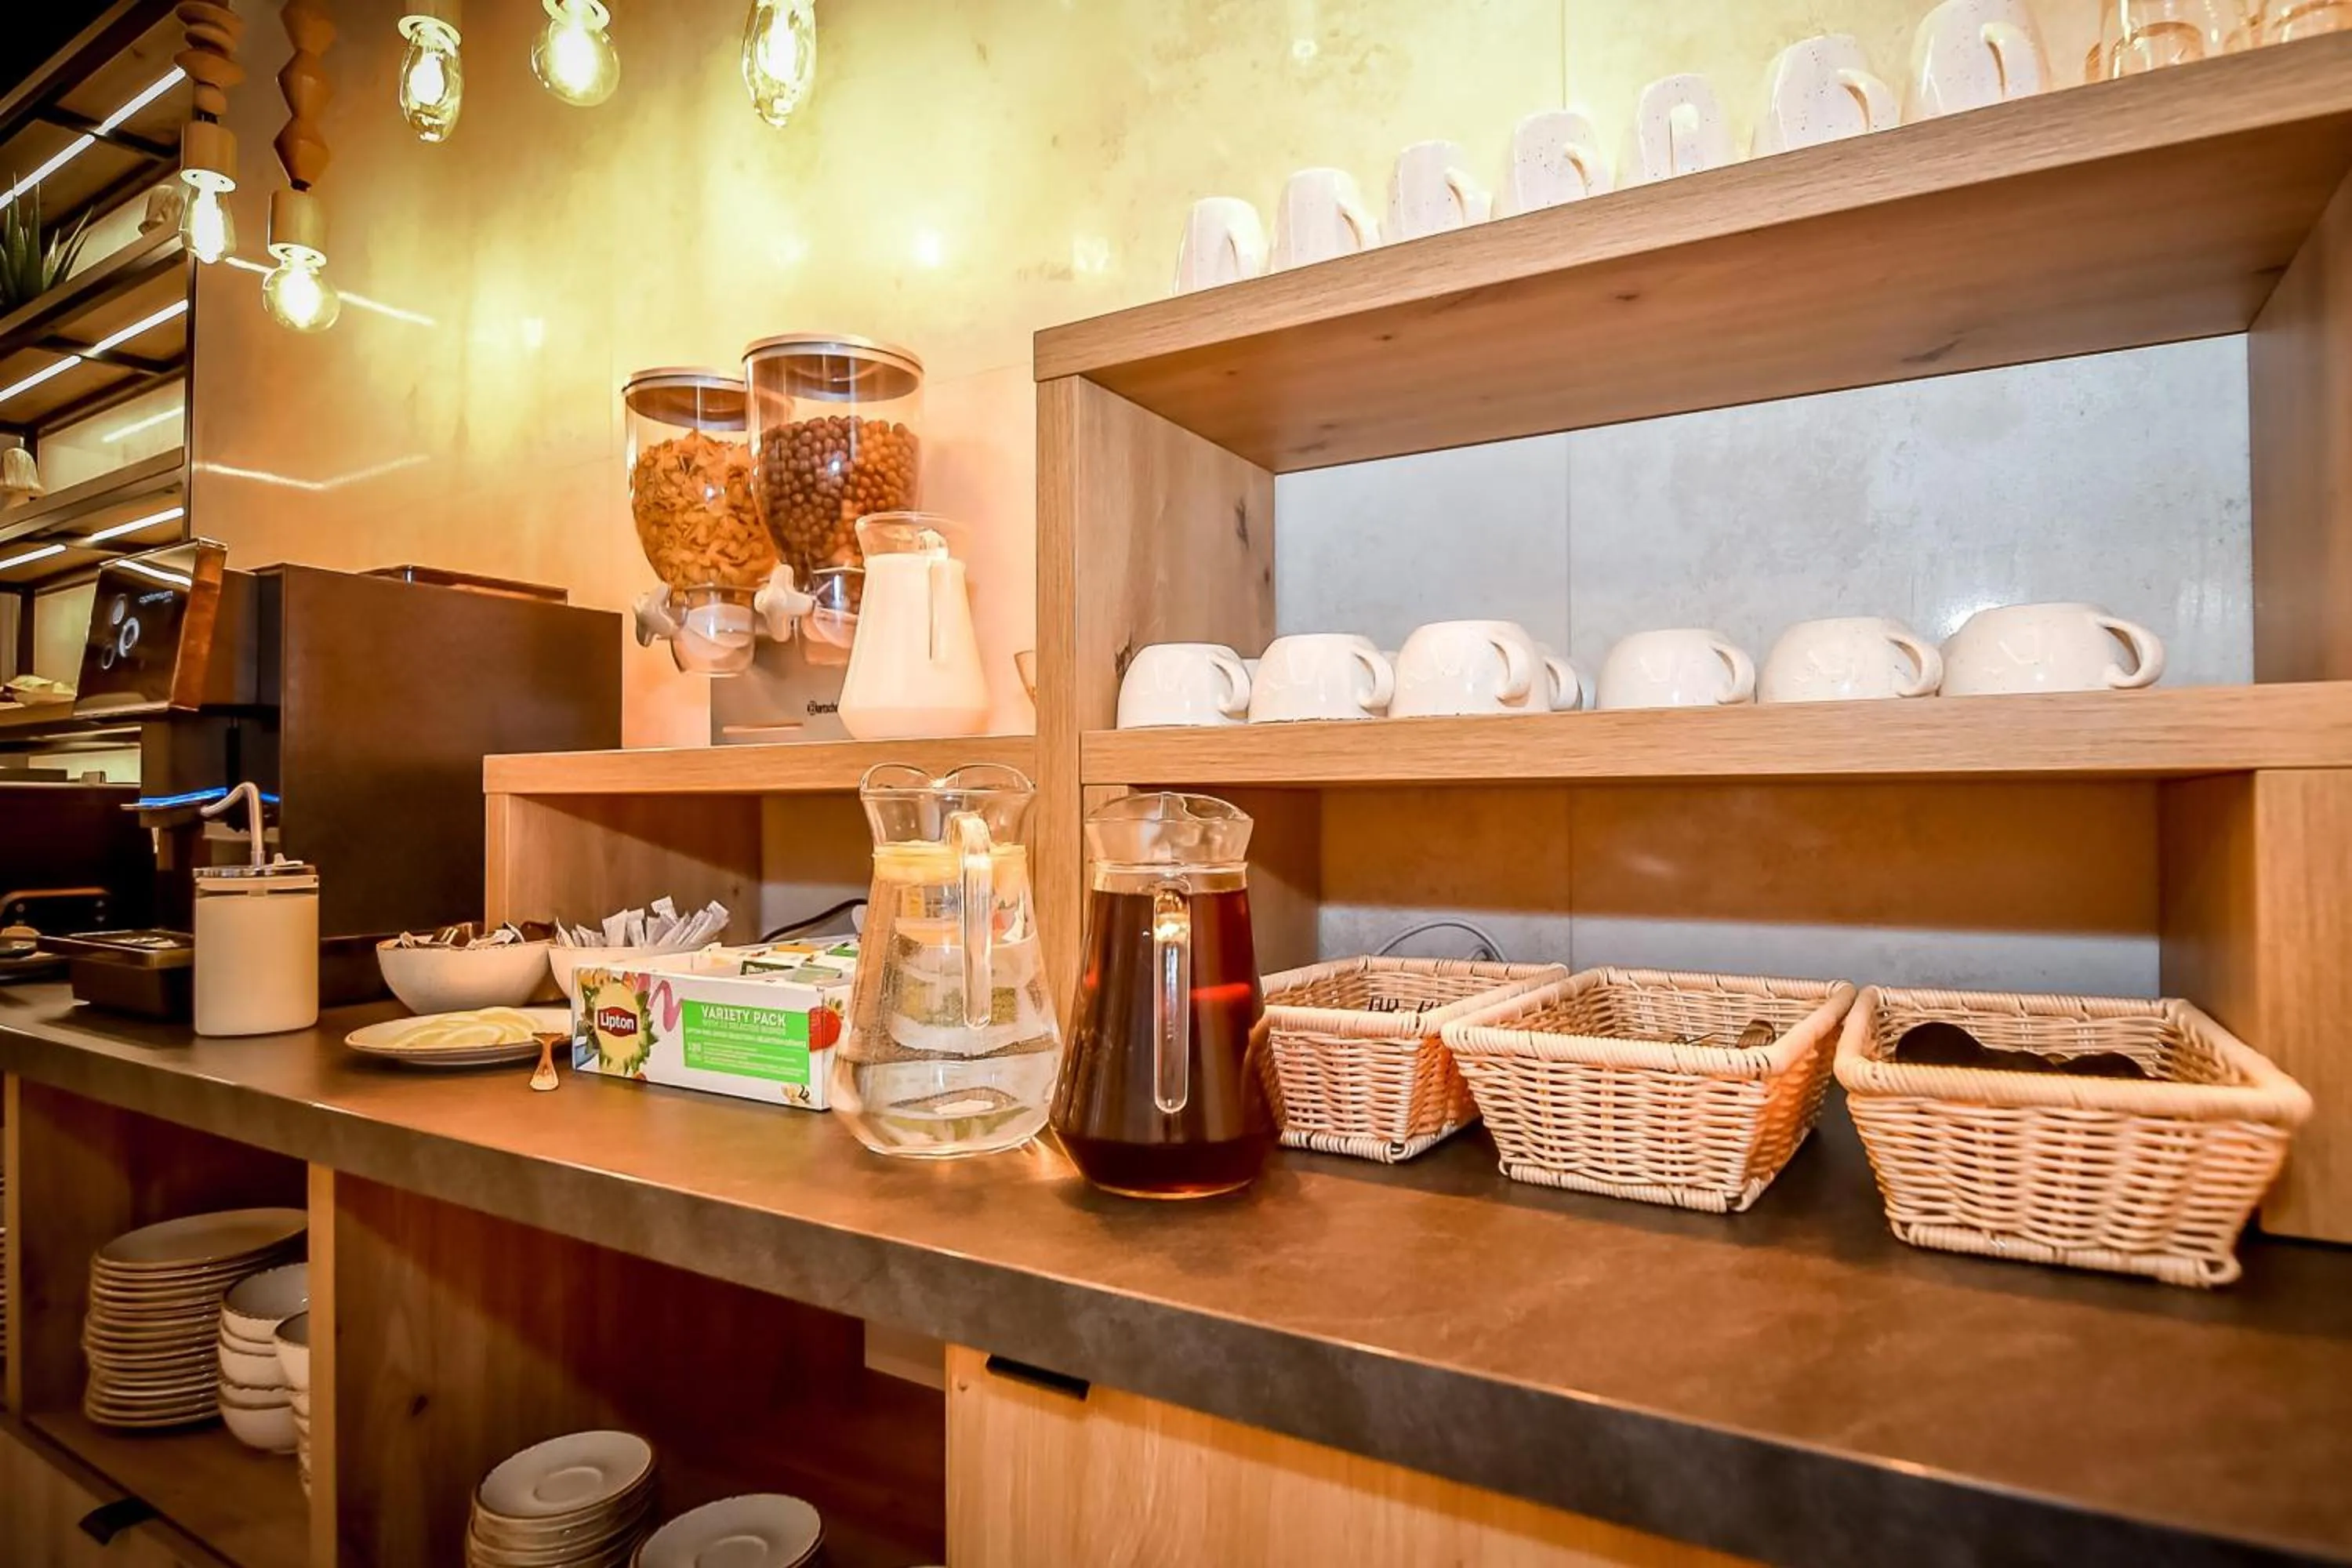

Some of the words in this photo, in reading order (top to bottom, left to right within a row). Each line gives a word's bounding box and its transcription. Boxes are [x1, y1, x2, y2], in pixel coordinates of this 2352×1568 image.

[600, 1011, 634, 1031] Lipton
[702, 1004, 750, 1022] VARIETY
[753, 1011, 786, 1026] PACK
